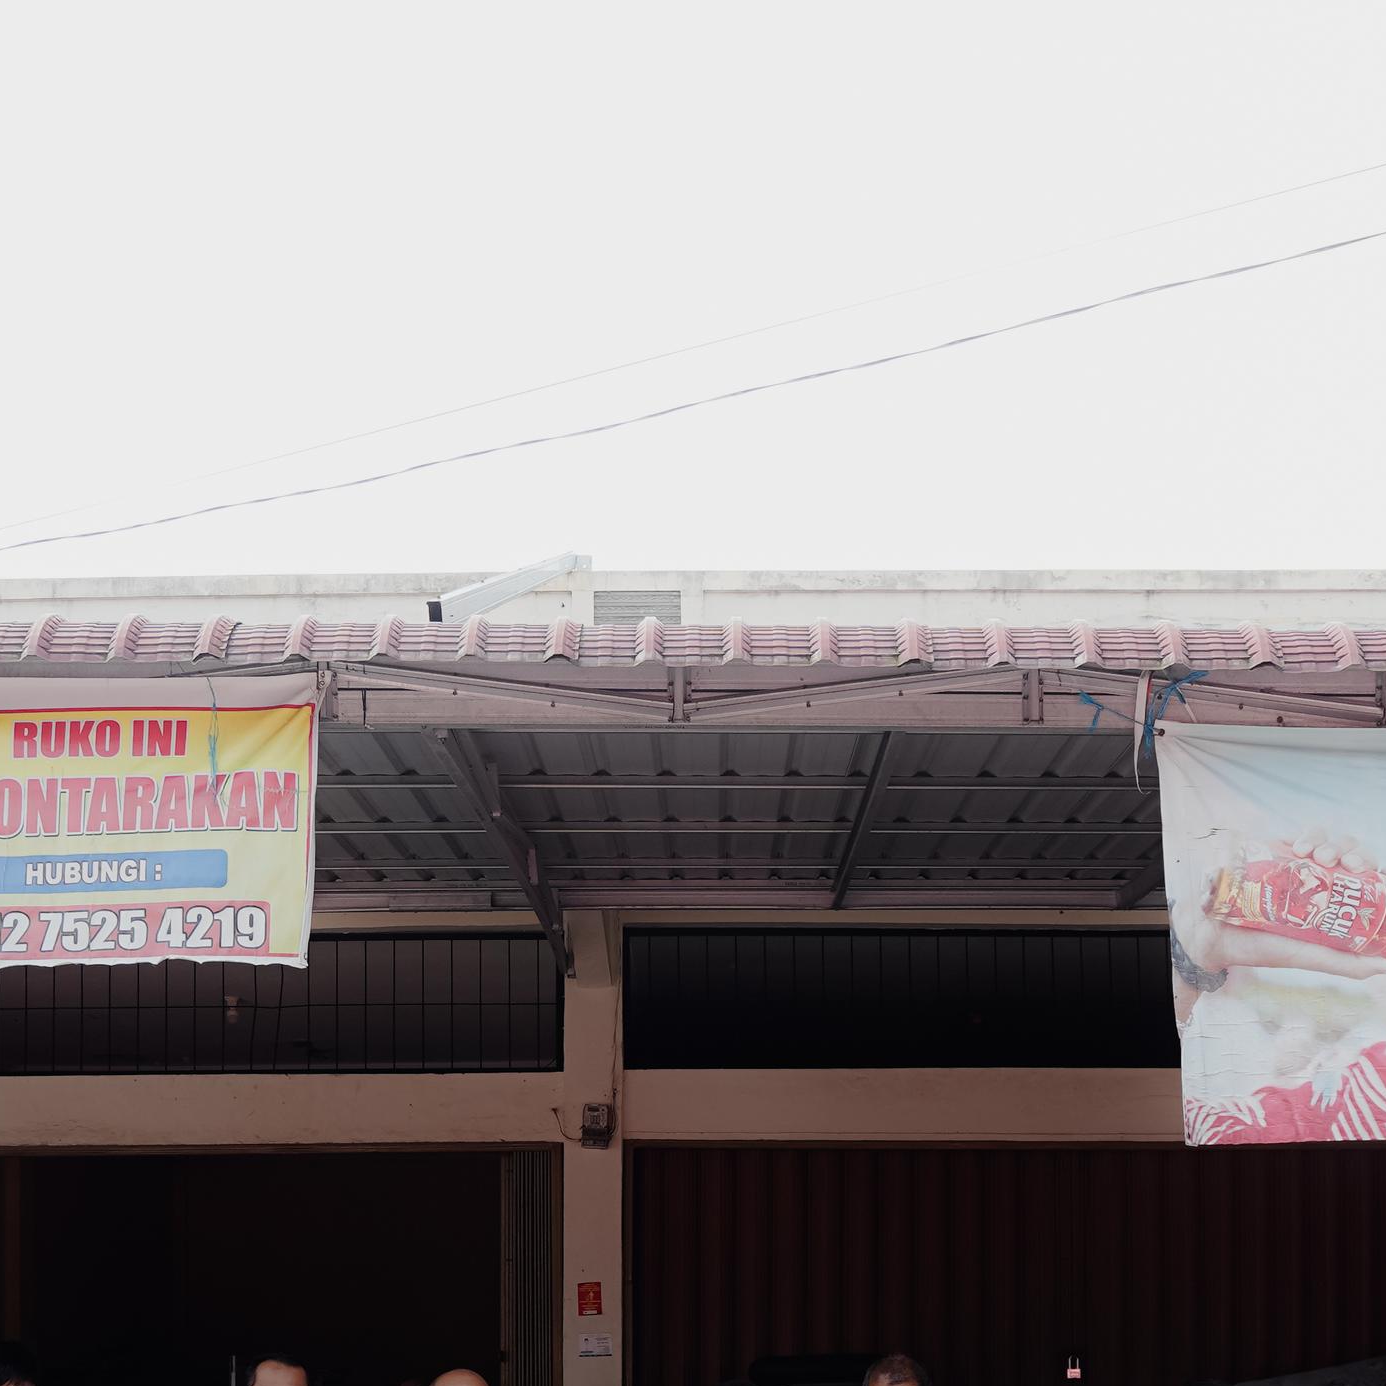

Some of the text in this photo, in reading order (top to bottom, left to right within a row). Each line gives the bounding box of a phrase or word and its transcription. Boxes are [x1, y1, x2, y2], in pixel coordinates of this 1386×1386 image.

[12, 718, 188, 758] RUKO INI
[25, 859, 147, 886] HUBUNGI
[39, 908, 147, 953] 7525
[158, 905, 268, 950] 4219
